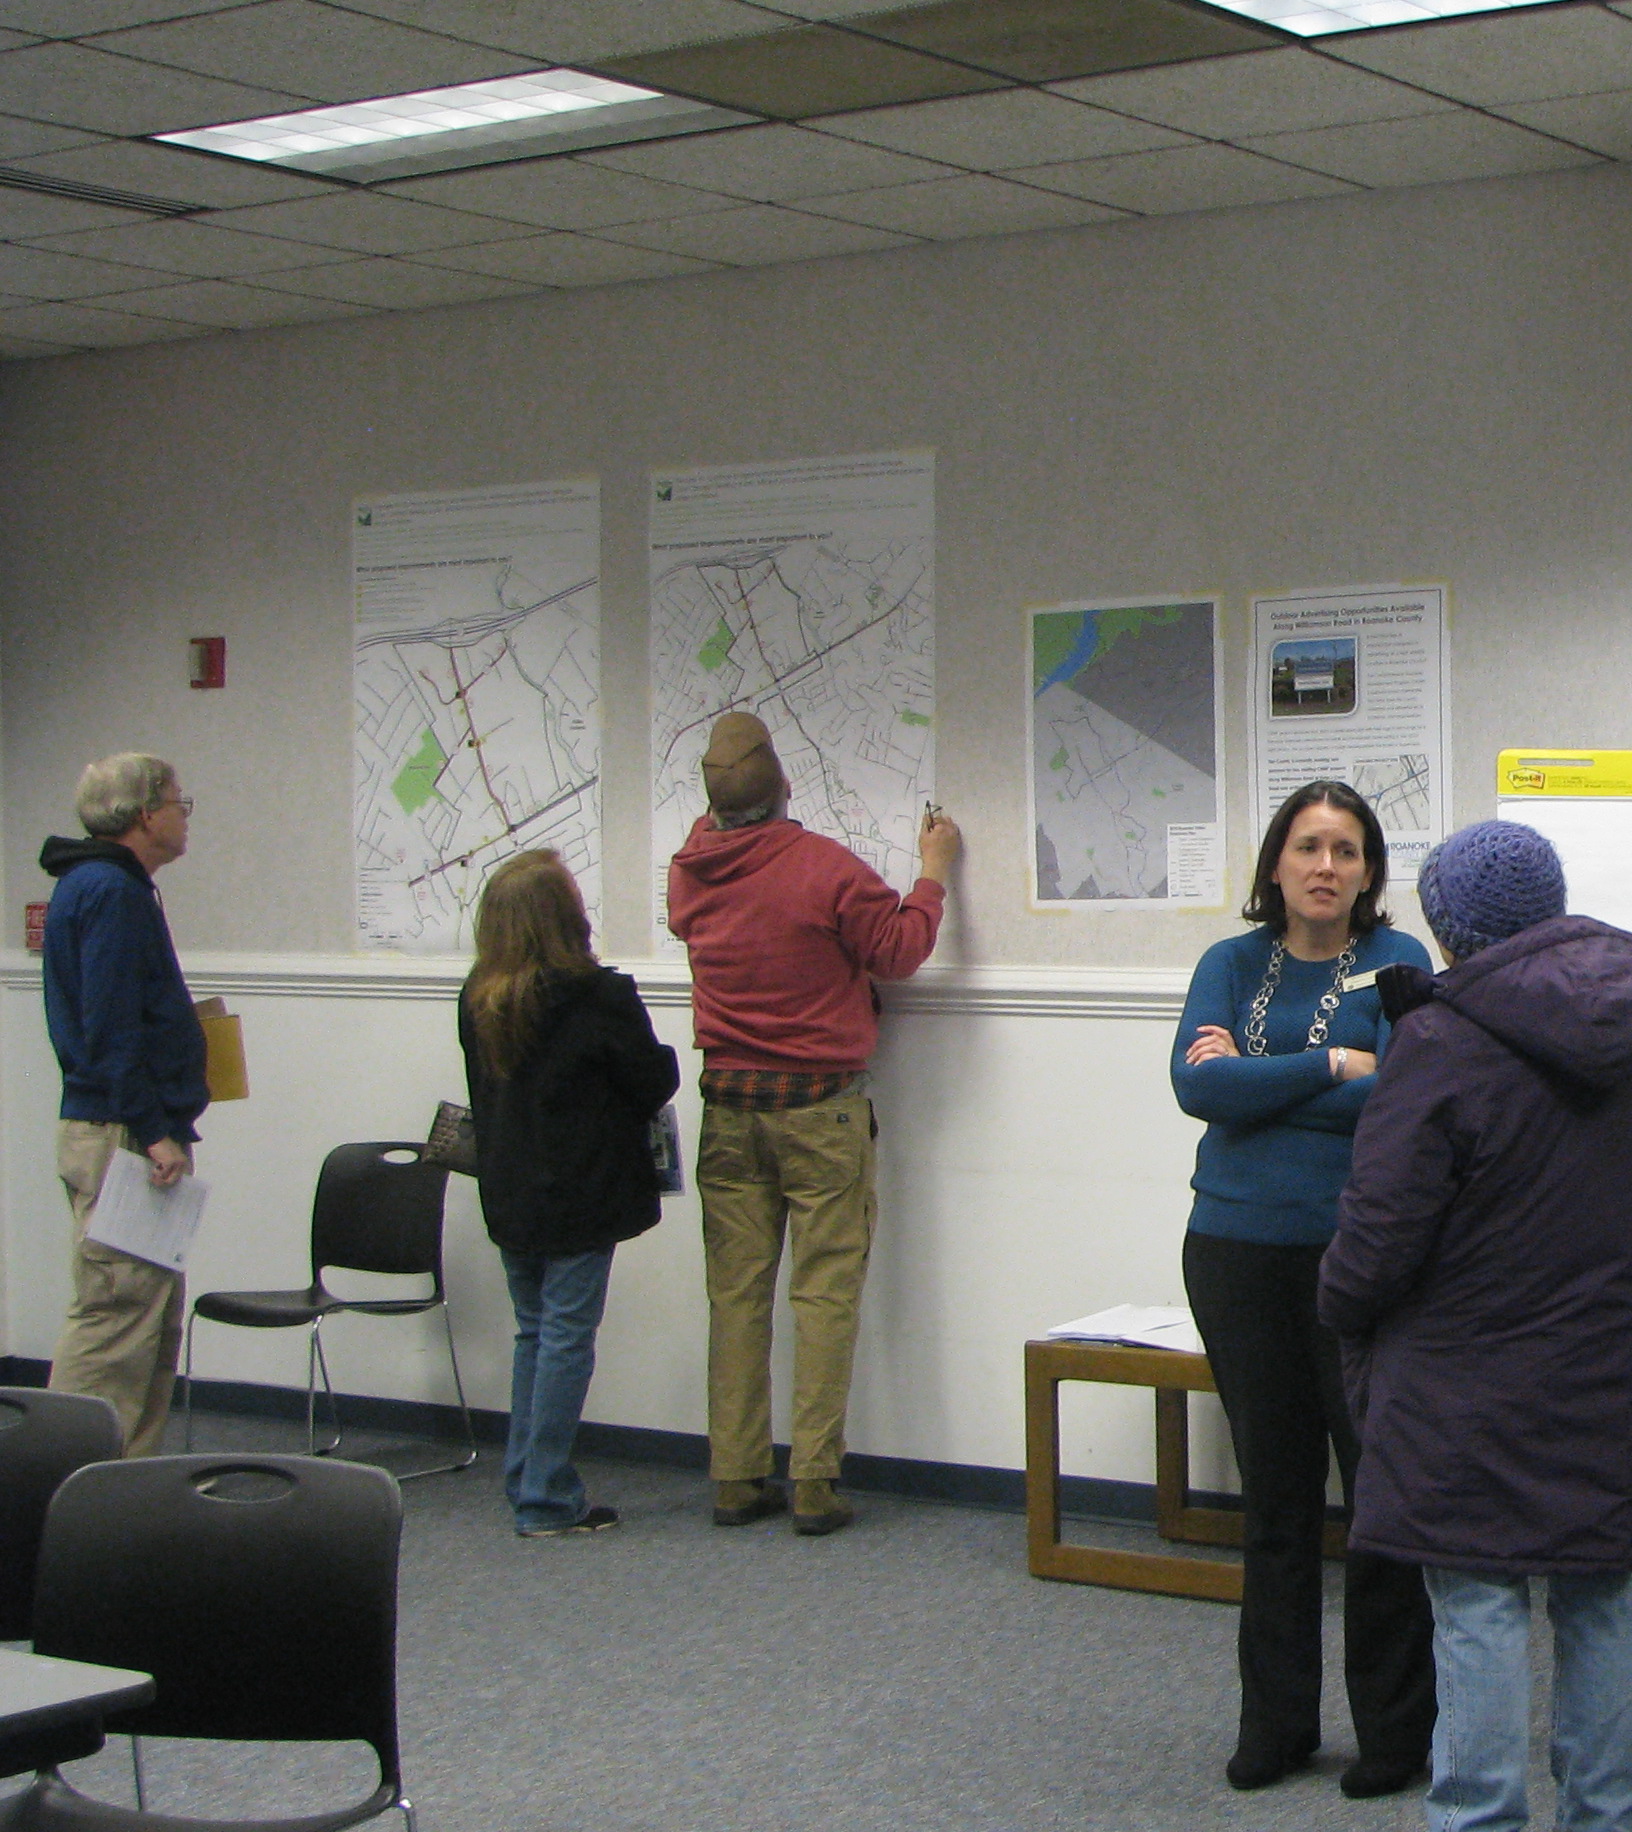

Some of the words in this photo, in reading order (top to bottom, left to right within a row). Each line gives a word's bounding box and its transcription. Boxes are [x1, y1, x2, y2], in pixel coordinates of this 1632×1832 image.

[1300, 608, 1339, 619] Advertising
[1340, 605, 1389, 616] Opportunities
[1390, 603, 1425, 612] Available
[1273, 623, 1294, 631] Along
[1333, 618, 1351, 627] Road
[1396, 614, 1423, 623] County
[1512, 774, 1541, 783] Post-it
